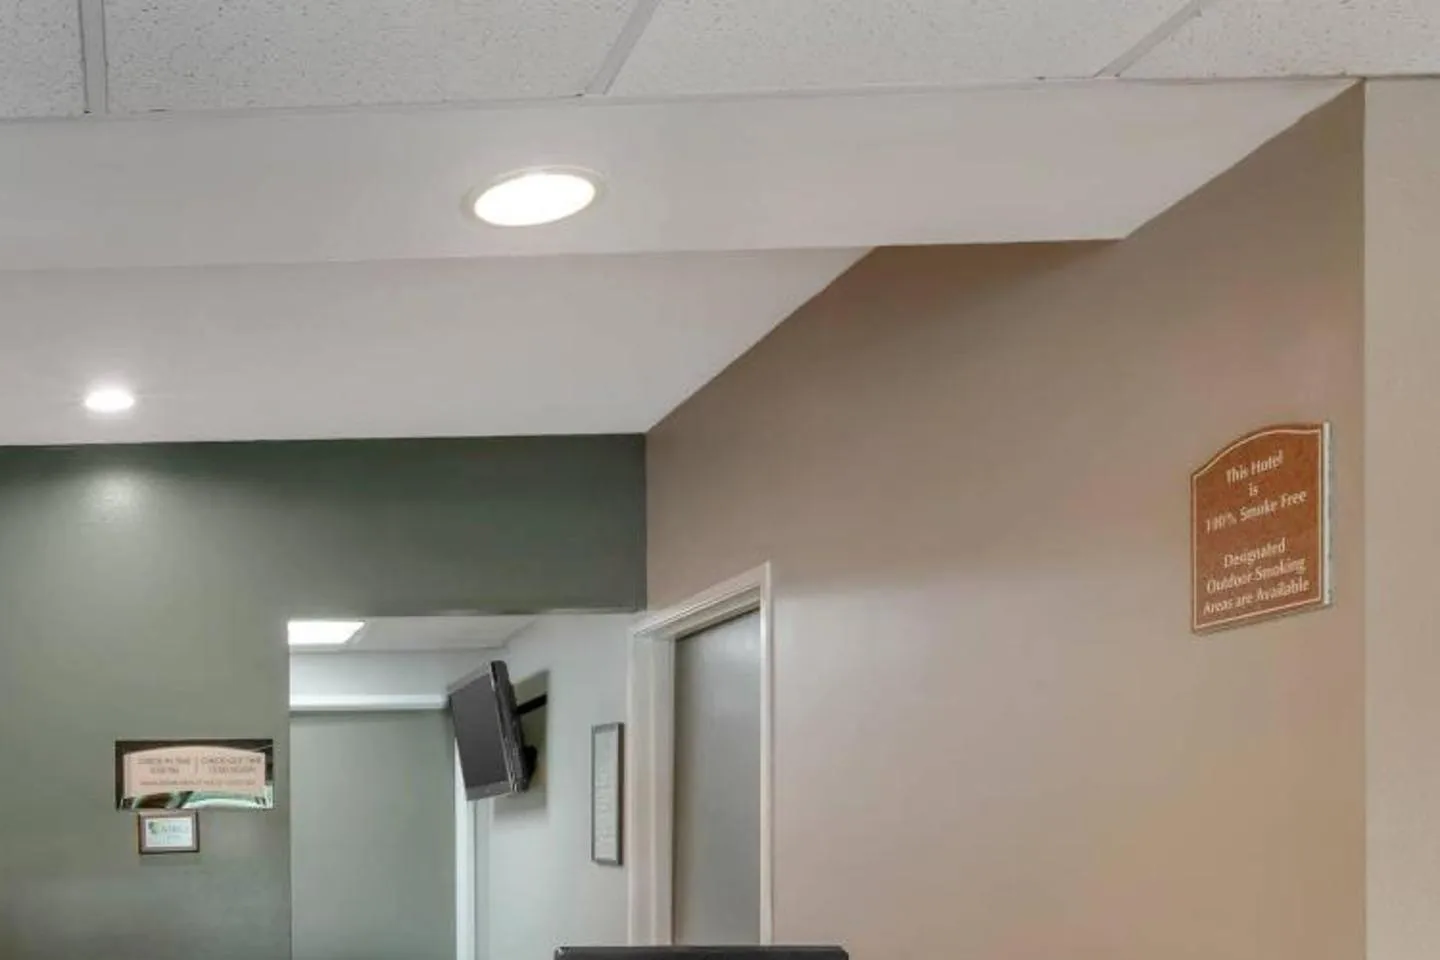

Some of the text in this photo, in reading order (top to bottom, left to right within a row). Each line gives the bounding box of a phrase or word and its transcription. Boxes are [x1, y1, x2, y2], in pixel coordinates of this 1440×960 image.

[1226, 450, 1283, 485] This Hotel
[1240, 498, 1278, 520] Smoke
[1280, 491, 1307, 508] Free
[1224, 537, 1286, 568] Designated
[1207, 558, 1306, 594] Outdoor Smoking
[1203, 600, 1233, 615] Areas
[1257, 577, 1310, 601] Available
